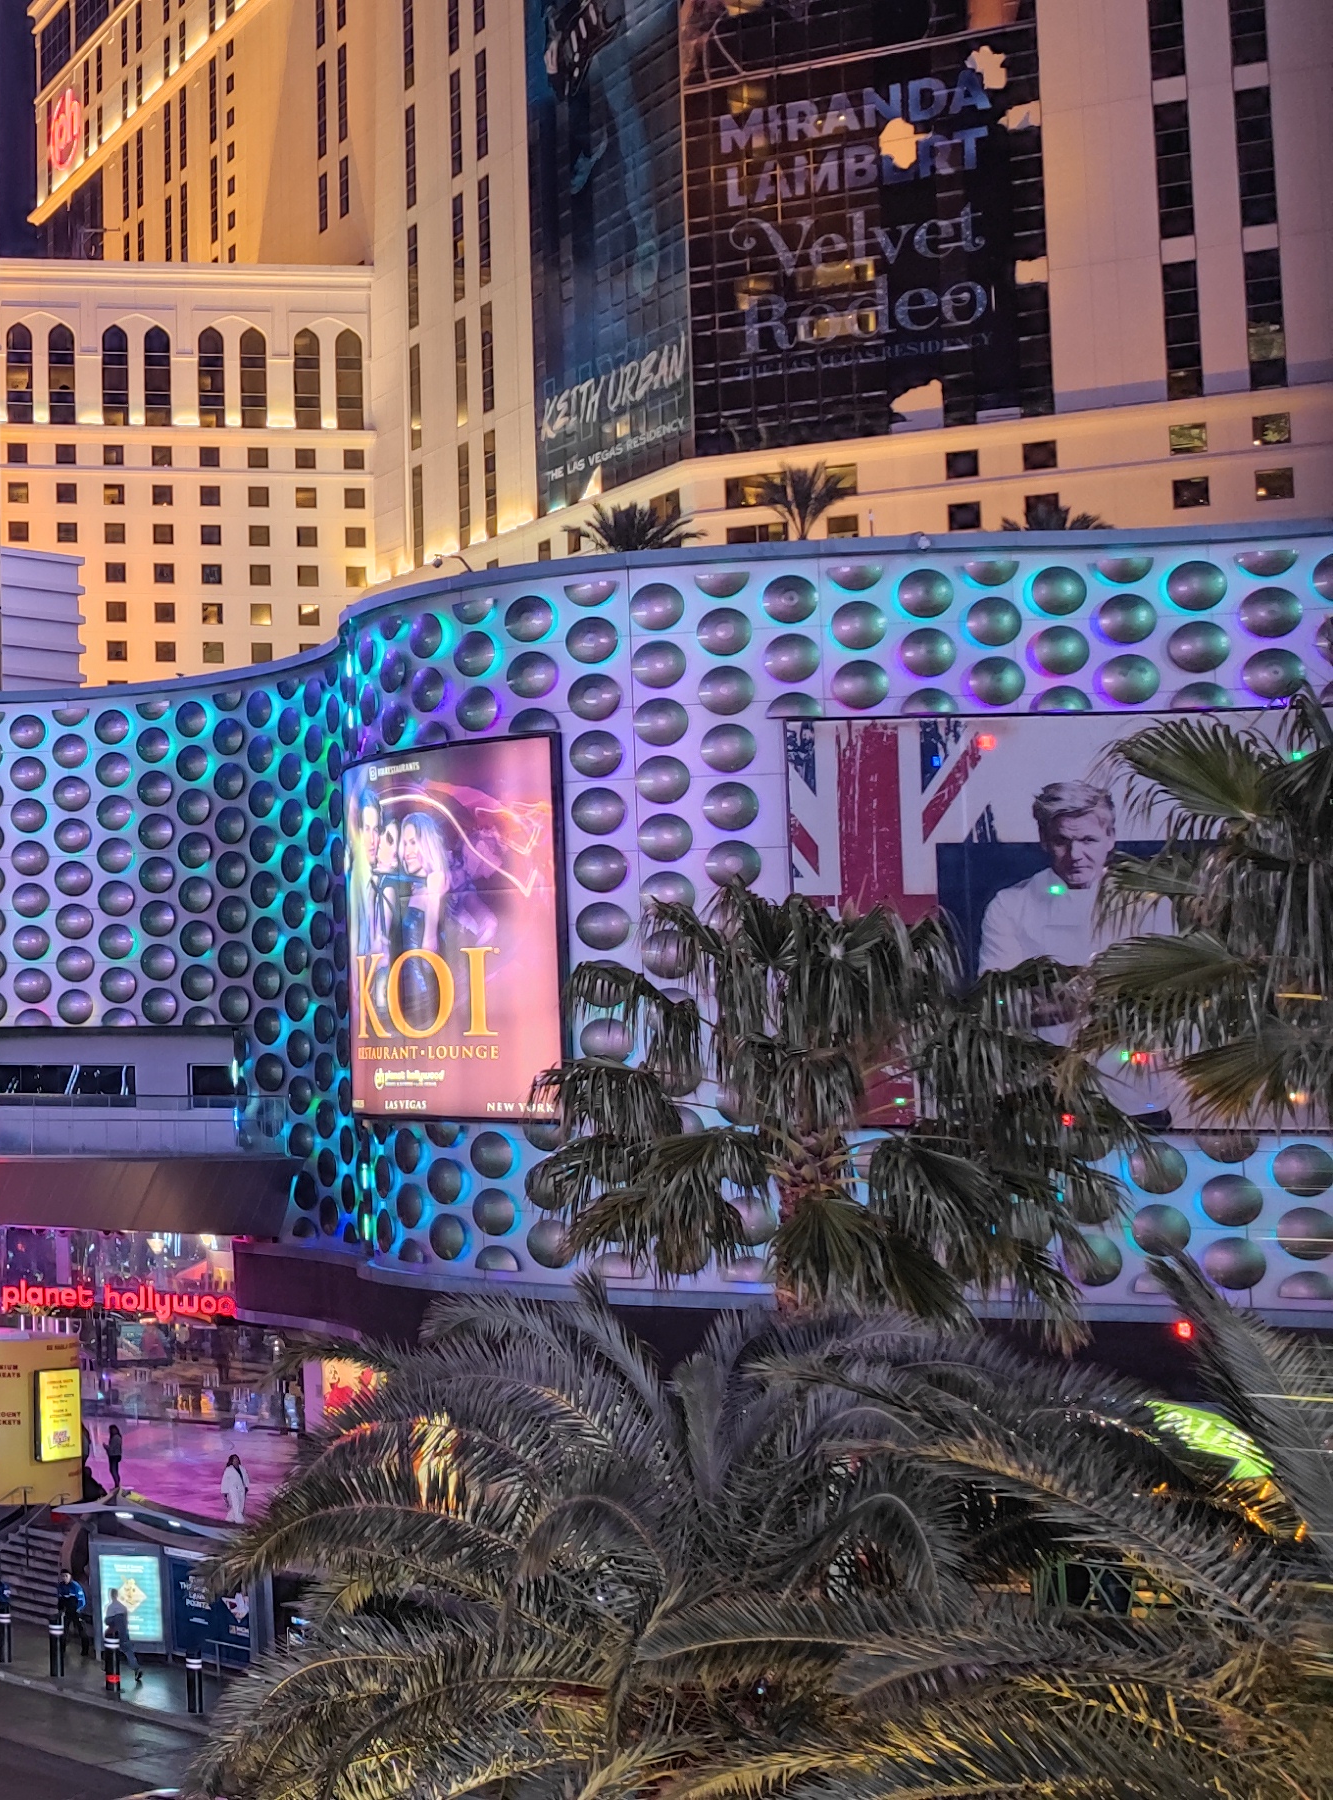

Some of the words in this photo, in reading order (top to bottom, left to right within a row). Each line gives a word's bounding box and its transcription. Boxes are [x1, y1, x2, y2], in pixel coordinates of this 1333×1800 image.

[719, 70, 992, 154] MIRANDA
[729, 201, 986, 277] Velvet
[739, 273, 988, 355] Rodeo
[540, 375, 605, 442] KEITH
[607, 331, 686, 413] URBAN
[544, 466, 565, 483] THE
[567, 458, 586, 475] LAS
[588, 442, 624, 467] VEGAS
[626, 416, 686, 451] RESIDENCY
[356, 946, 500, 1039] KOI
[358, 1045, 419, 1060] RESTAURANT
[428, 1045, 500, 1060] LOUNGE
[385, 1099, 399, 1110] LAS
[399, 1099, 427, 1110] VEGAS
[486, 1101, 515, 1112] NEW
[1, 1279, 94, 1311] planet
